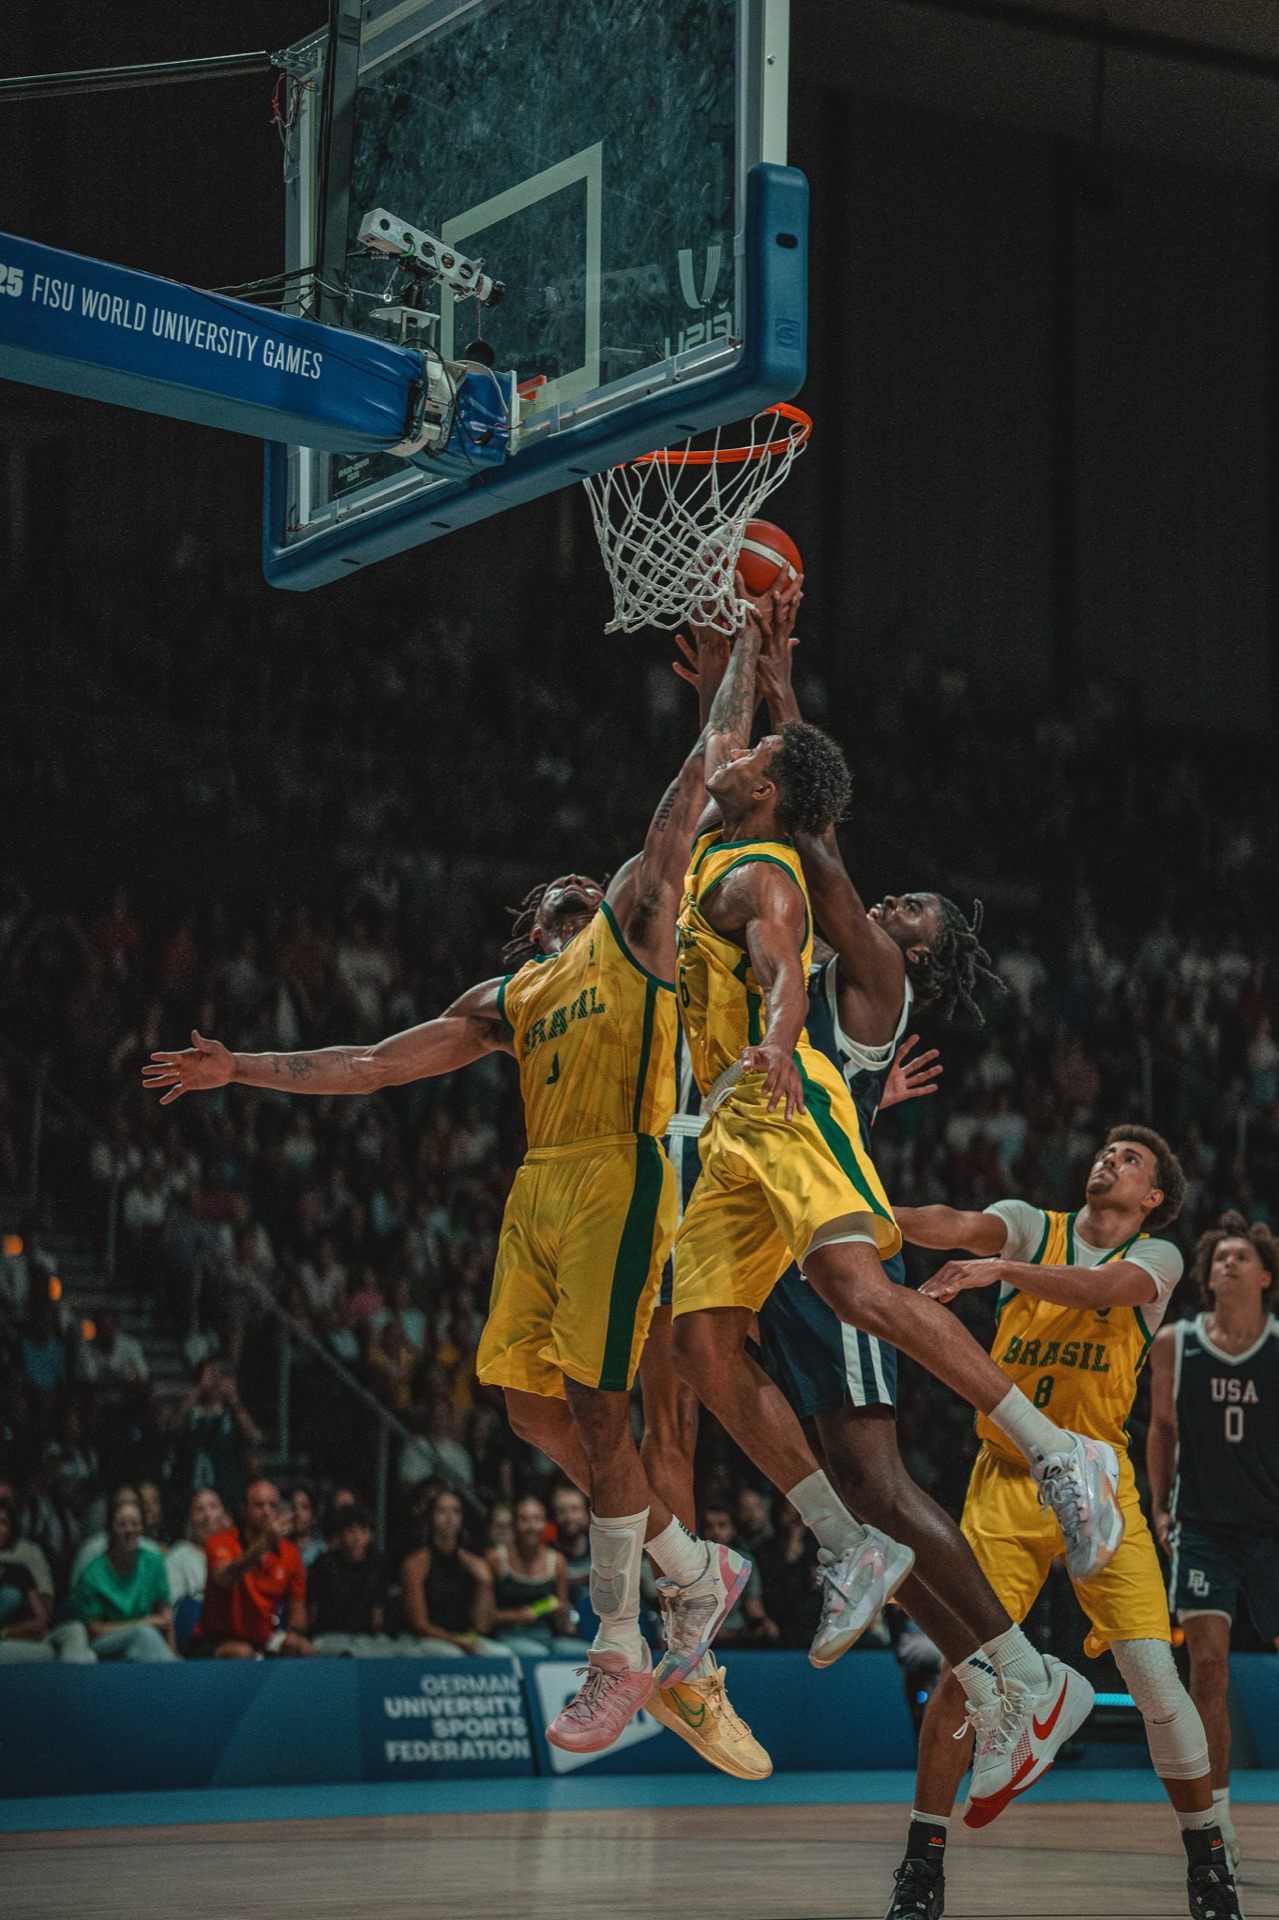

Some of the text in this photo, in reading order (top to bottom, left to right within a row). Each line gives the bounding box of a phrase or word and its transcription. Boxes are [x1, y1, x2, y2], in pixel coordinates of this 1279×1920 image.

[31, 273, 75, 312] FISU
[81, 287, 147, 331] WORLD
[152, 307, 258, 362] UNIVERSITY
[262, 338, 323, 380] GAMES
[1003, 1336, 1109, 1372] BRASIL
[1033, 1375, 1055, 1409] 8
[1210, 1377, 1259, 1404] USA
[1224, 1405, 1244, 1443] 0
[421, 1674, 519, 1696] GERMAN
[385, 1697, 521, 1718] UNIVERSITY
[433, 1717, 527, 1738] SPORTS
[385, 1740, 531, 1762] FEDERATION
